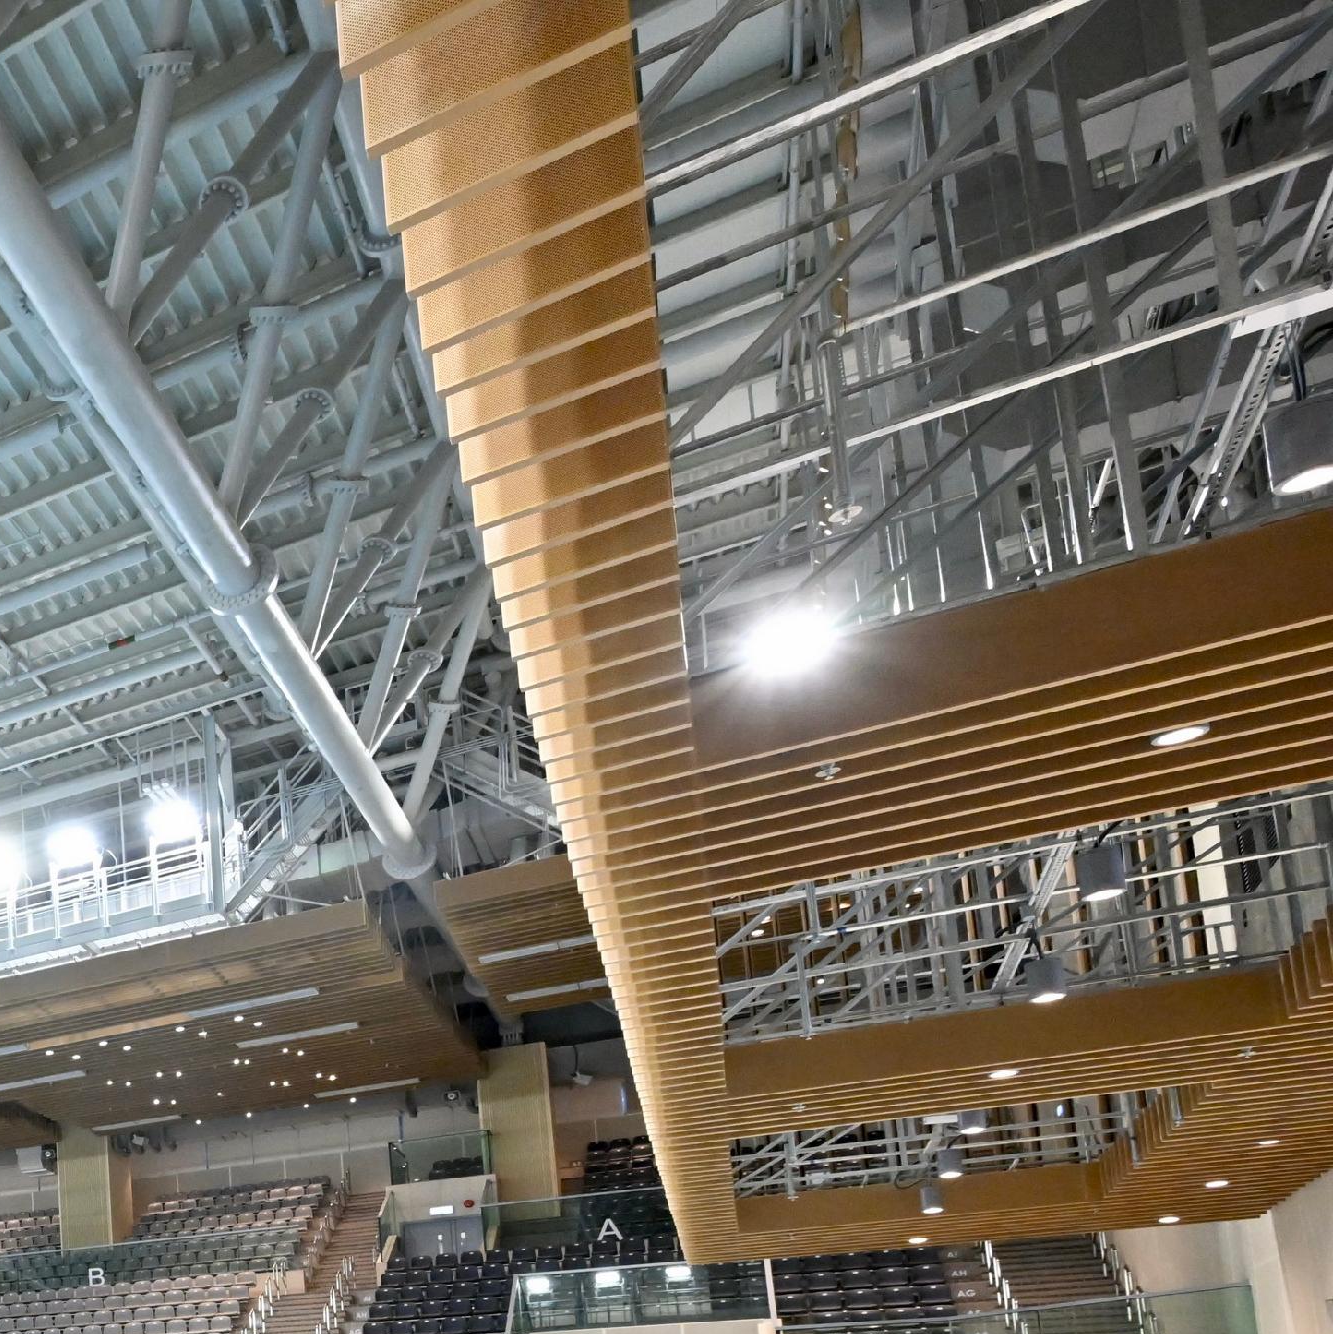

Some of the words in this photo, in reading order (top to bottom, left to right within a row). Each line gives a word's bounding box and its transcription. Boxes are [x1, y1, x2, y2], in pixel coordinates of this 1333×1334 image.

[597, 1218, 623, 1241] A
[88, 1267, 106, 1287] B
[957, 1289, 976, 1298] AG
